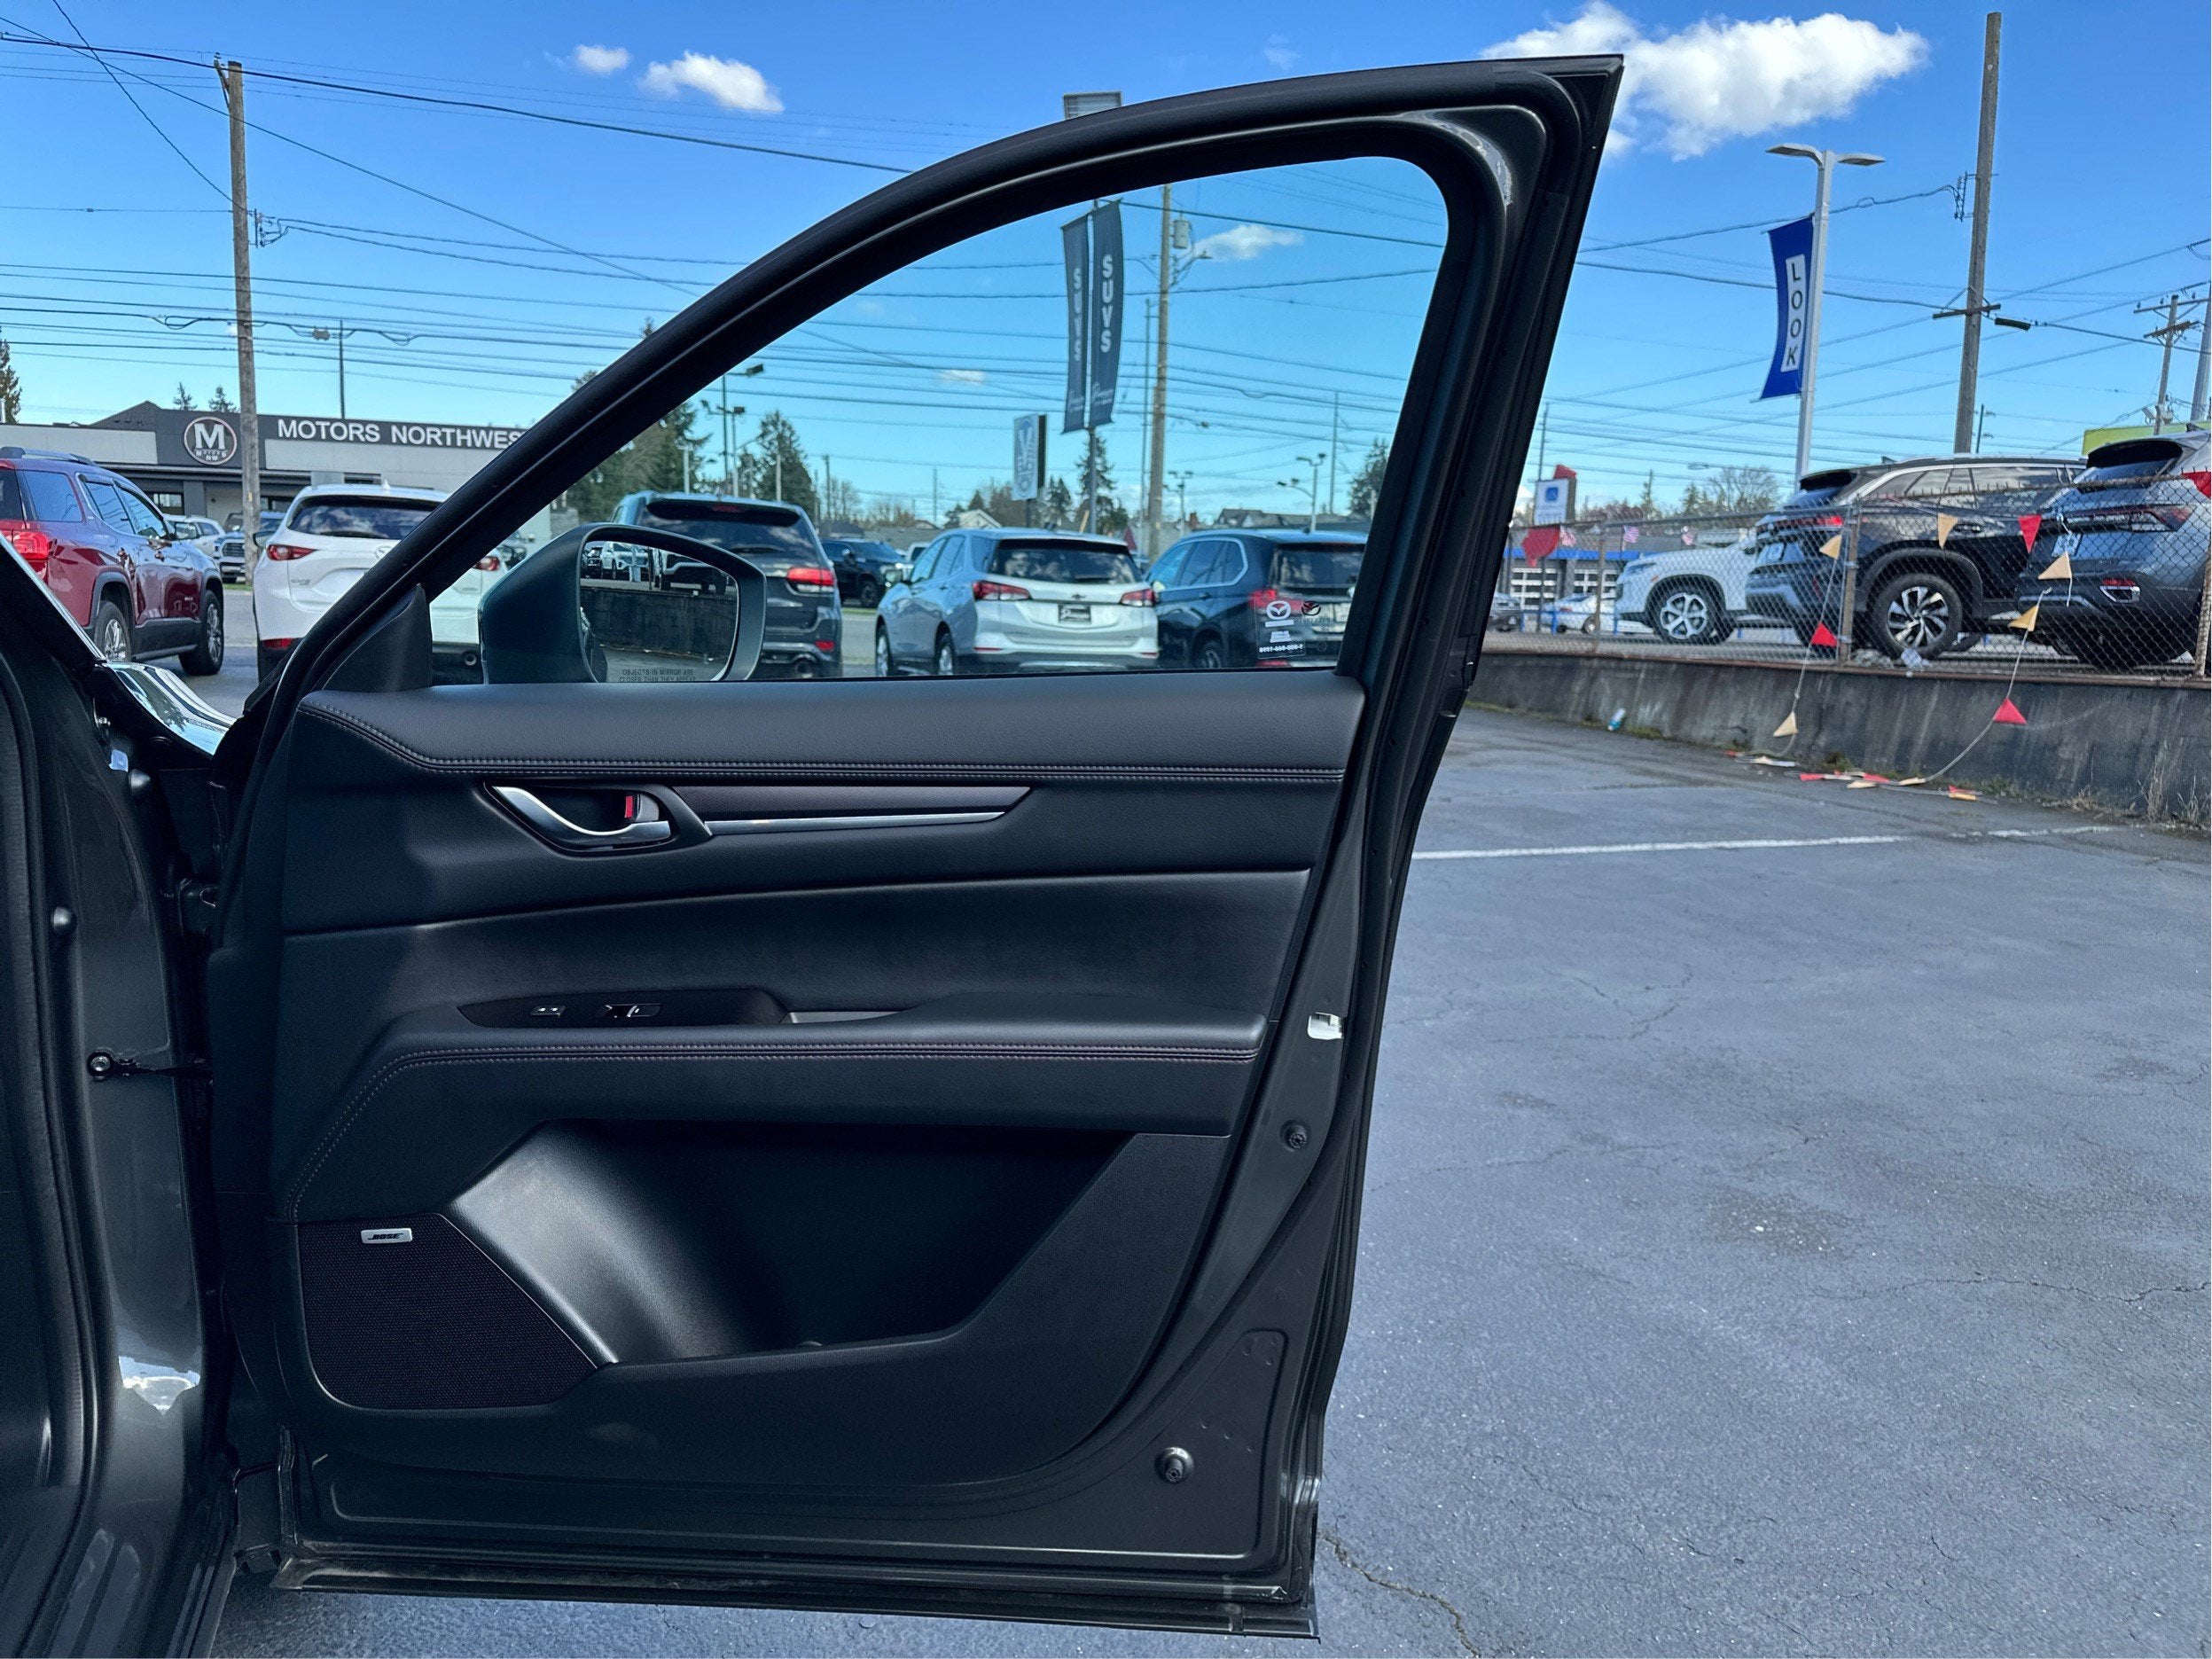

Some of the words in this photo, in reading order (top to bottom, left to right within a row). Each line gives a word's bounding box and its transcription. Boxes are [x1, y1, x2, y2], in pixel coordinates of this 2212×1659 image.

[1101, 254, 1114, 353] SUVS
[1786, 262, 1802, 366] LOOK
[194, 423, 225, 450] M
[277, 419, 380, 442] MOTORS
[391, 425, 525, 449] NORTHWES
